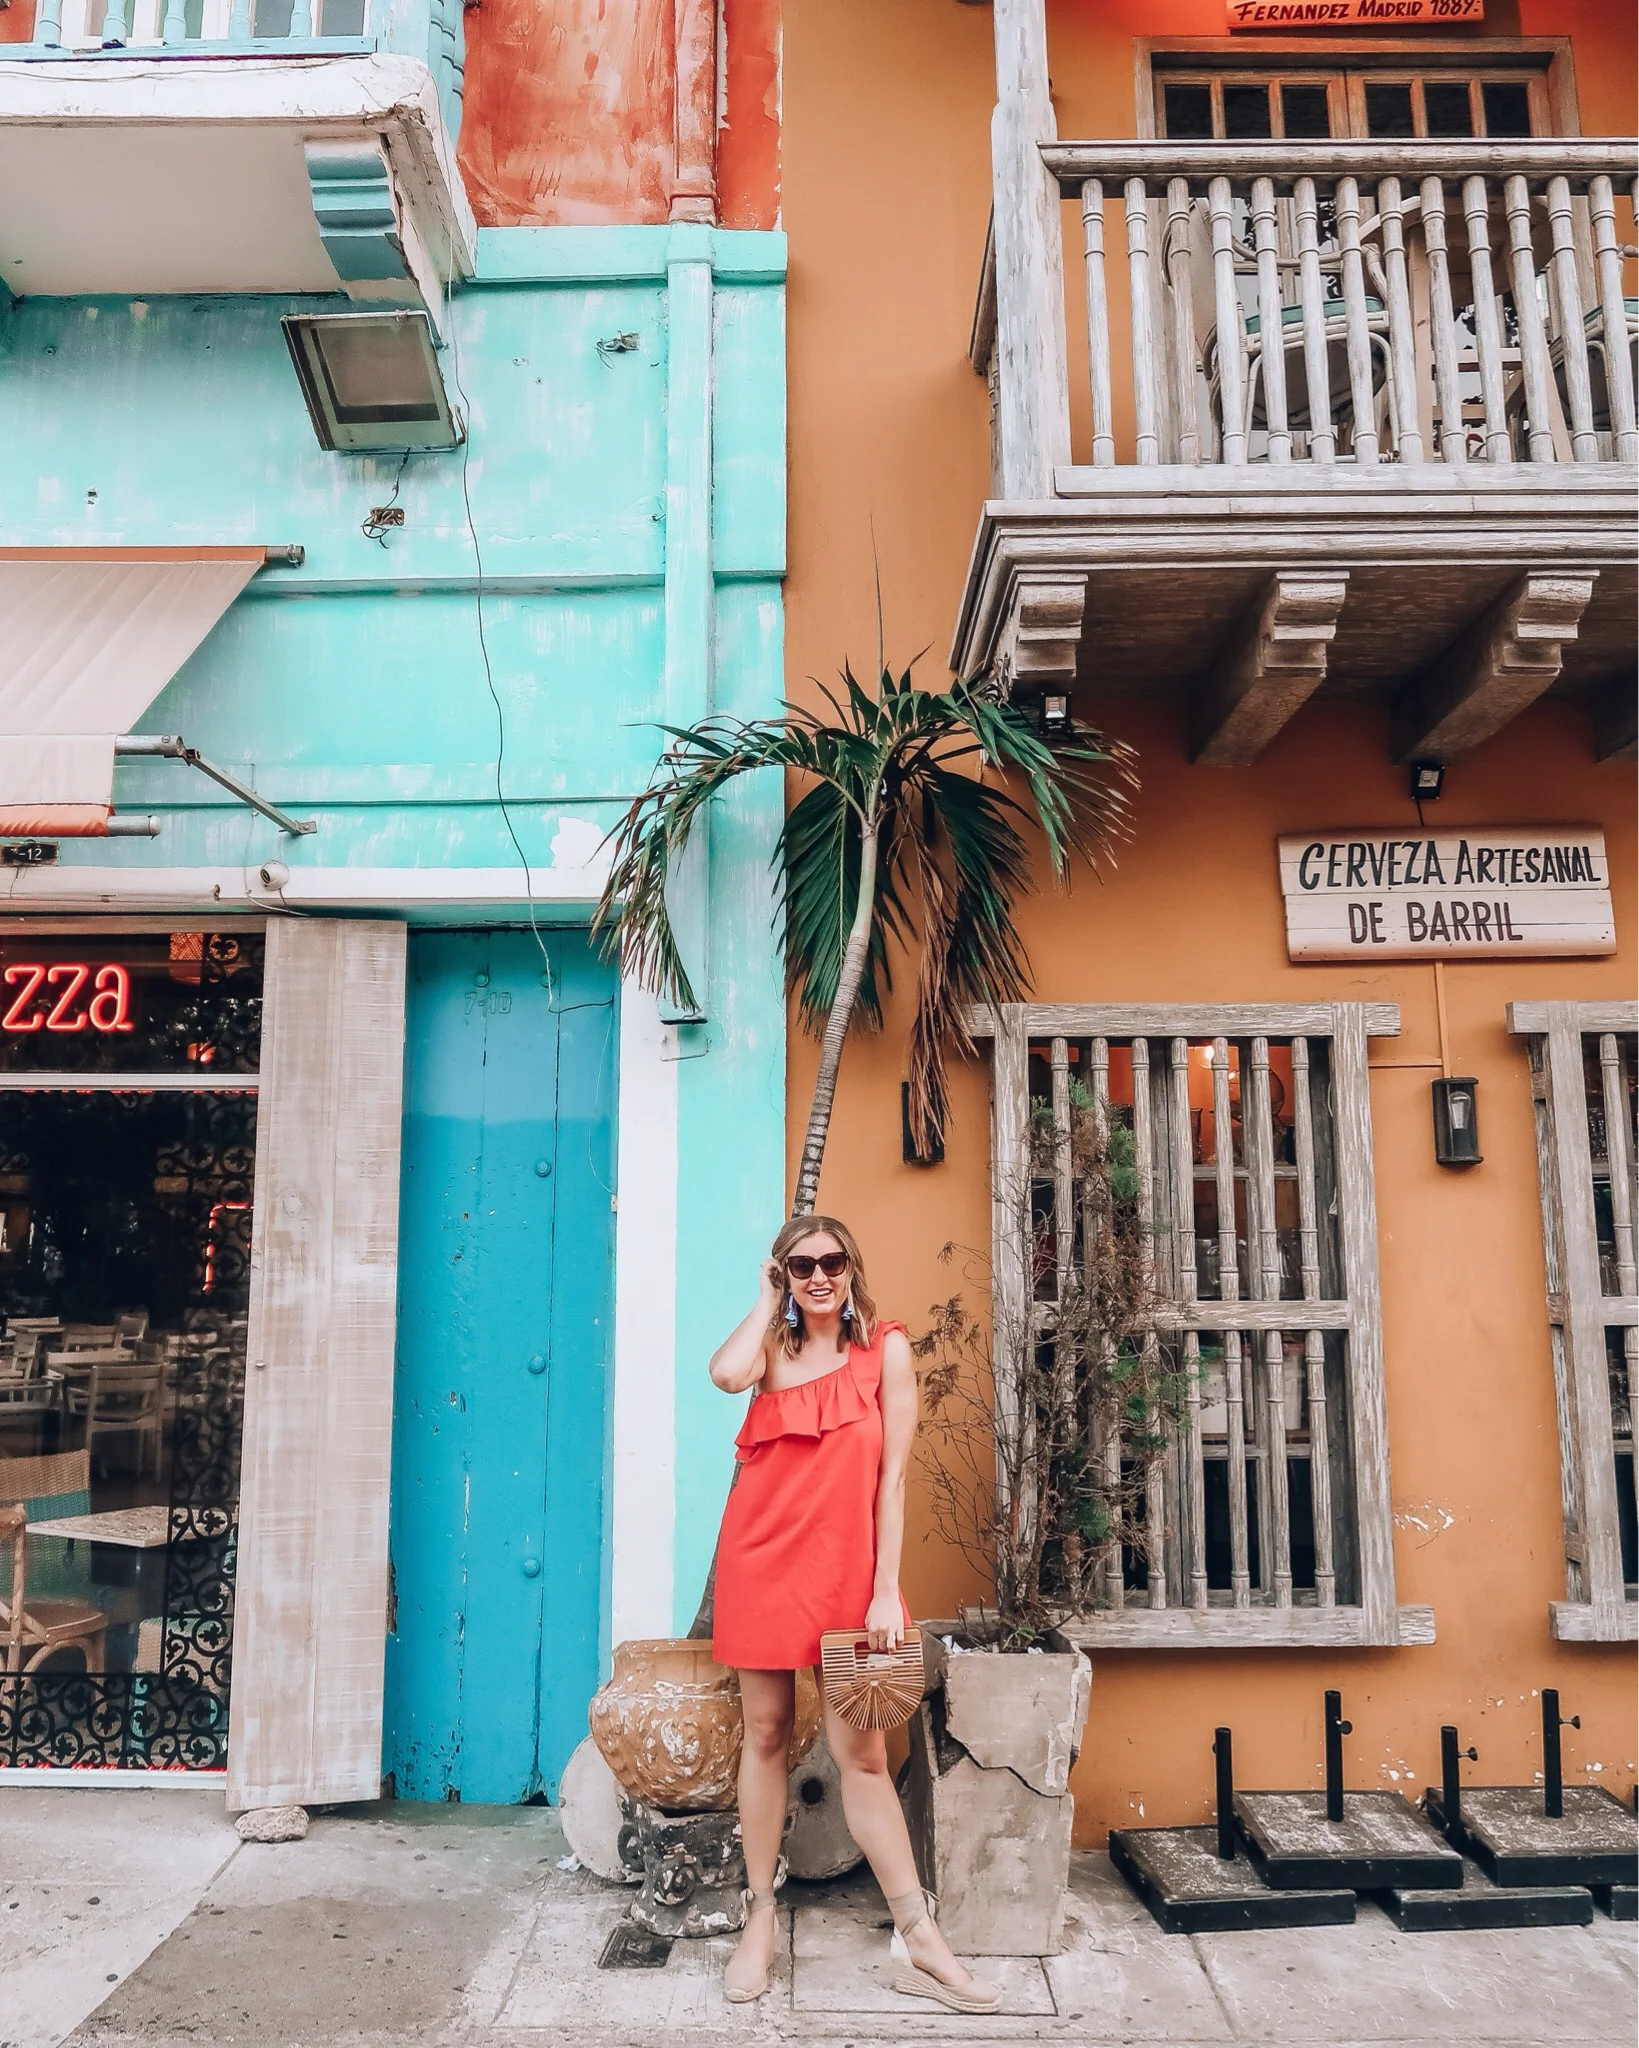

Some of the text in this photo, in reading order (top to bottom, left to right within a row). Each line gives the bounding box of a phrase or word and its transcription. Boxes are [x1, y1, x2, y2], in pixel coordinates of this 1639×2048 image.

[1234, 1, 1350, 21] FERNANDEZ
[1357, 0, 1423, 17] MADRID
[1299, 838, 1602, 891] CERVEZA ARTESANAL
[1348, 900, 1524, 944] DE BARRIL
